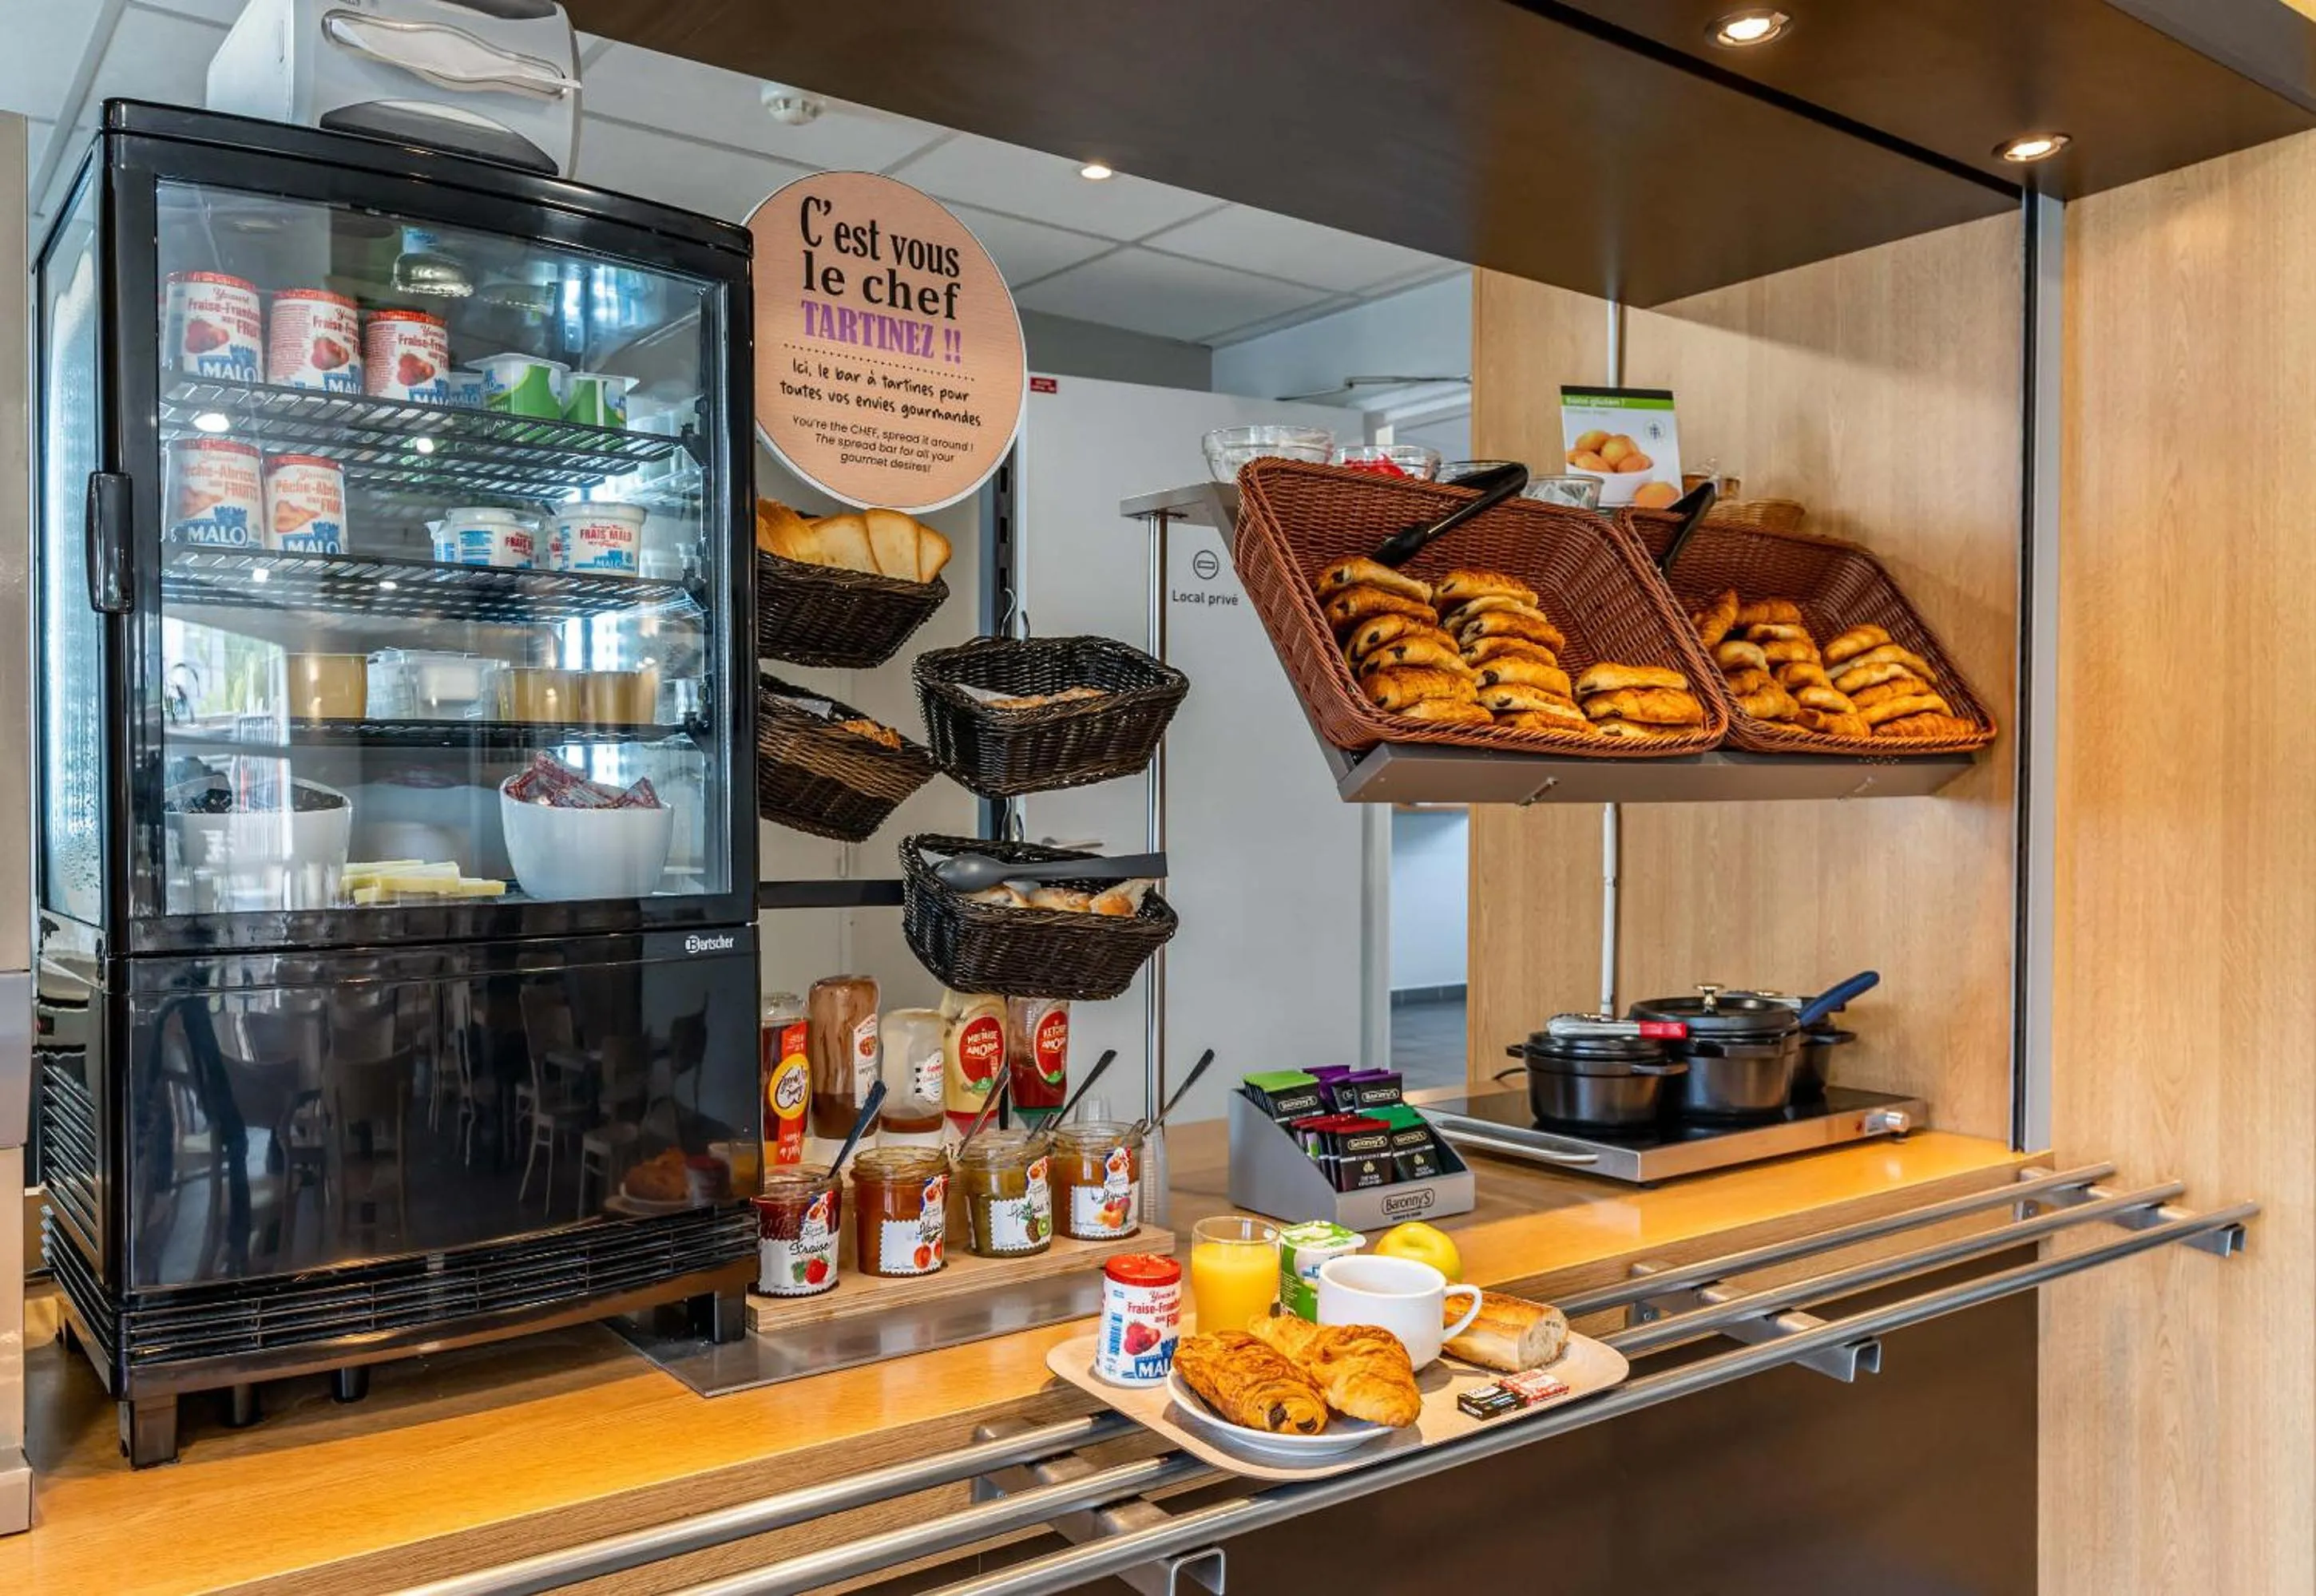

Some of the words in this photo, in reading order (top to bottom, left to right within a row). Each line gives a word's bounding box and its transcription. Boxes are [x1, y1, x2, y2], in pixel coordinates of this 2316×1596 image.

[800, 196, 881, 261] C'est
[890, 234, 961, 278] vous
[803, 250, 845, 296] le
[863, 267, 961, 320] chef
[801, 300, 935, 360] TARTINEZ
[792, 358, 811, 377] Ici,
[818, 363, 829, 379] le
[835, 367, 862, 383] bar
[867, 370, 876, 385] à
[882, 374, 934, 397] tartines
[939, 387, 970, 403] pour
[779, 380, 823, 400] toutes
[827, 392, 850, 405] vos
[855, 395, 895, 413] envies
[901, 404, 982, 426] gourmandes
[792, 414, 827, 430] You're
[829, 421, 848, 434] the
[882, 430, 920, 445] spread
[921, 434, 930, 446] it
[930, 438, 968, 451] around
[815, 433, 835, 446] The
[838, 437, 876, 452] spread
[878, 442, 898, 455] bar
[899, 446, 914, 457] for
[916, 448, 930, 458] all
[931, 453, 955, 463] your
[840, 452, 888, 468] gourmet
[187, 525, 247, 545] MALO
[286, 540, 340, 552] MALO
[1172, 588, 1205, 604] Local
[1208, 593, 1239, 607] privé
[966, 1042, 999, 1056] AMORA
[1139, 1358, 1169, 1378] MAL
